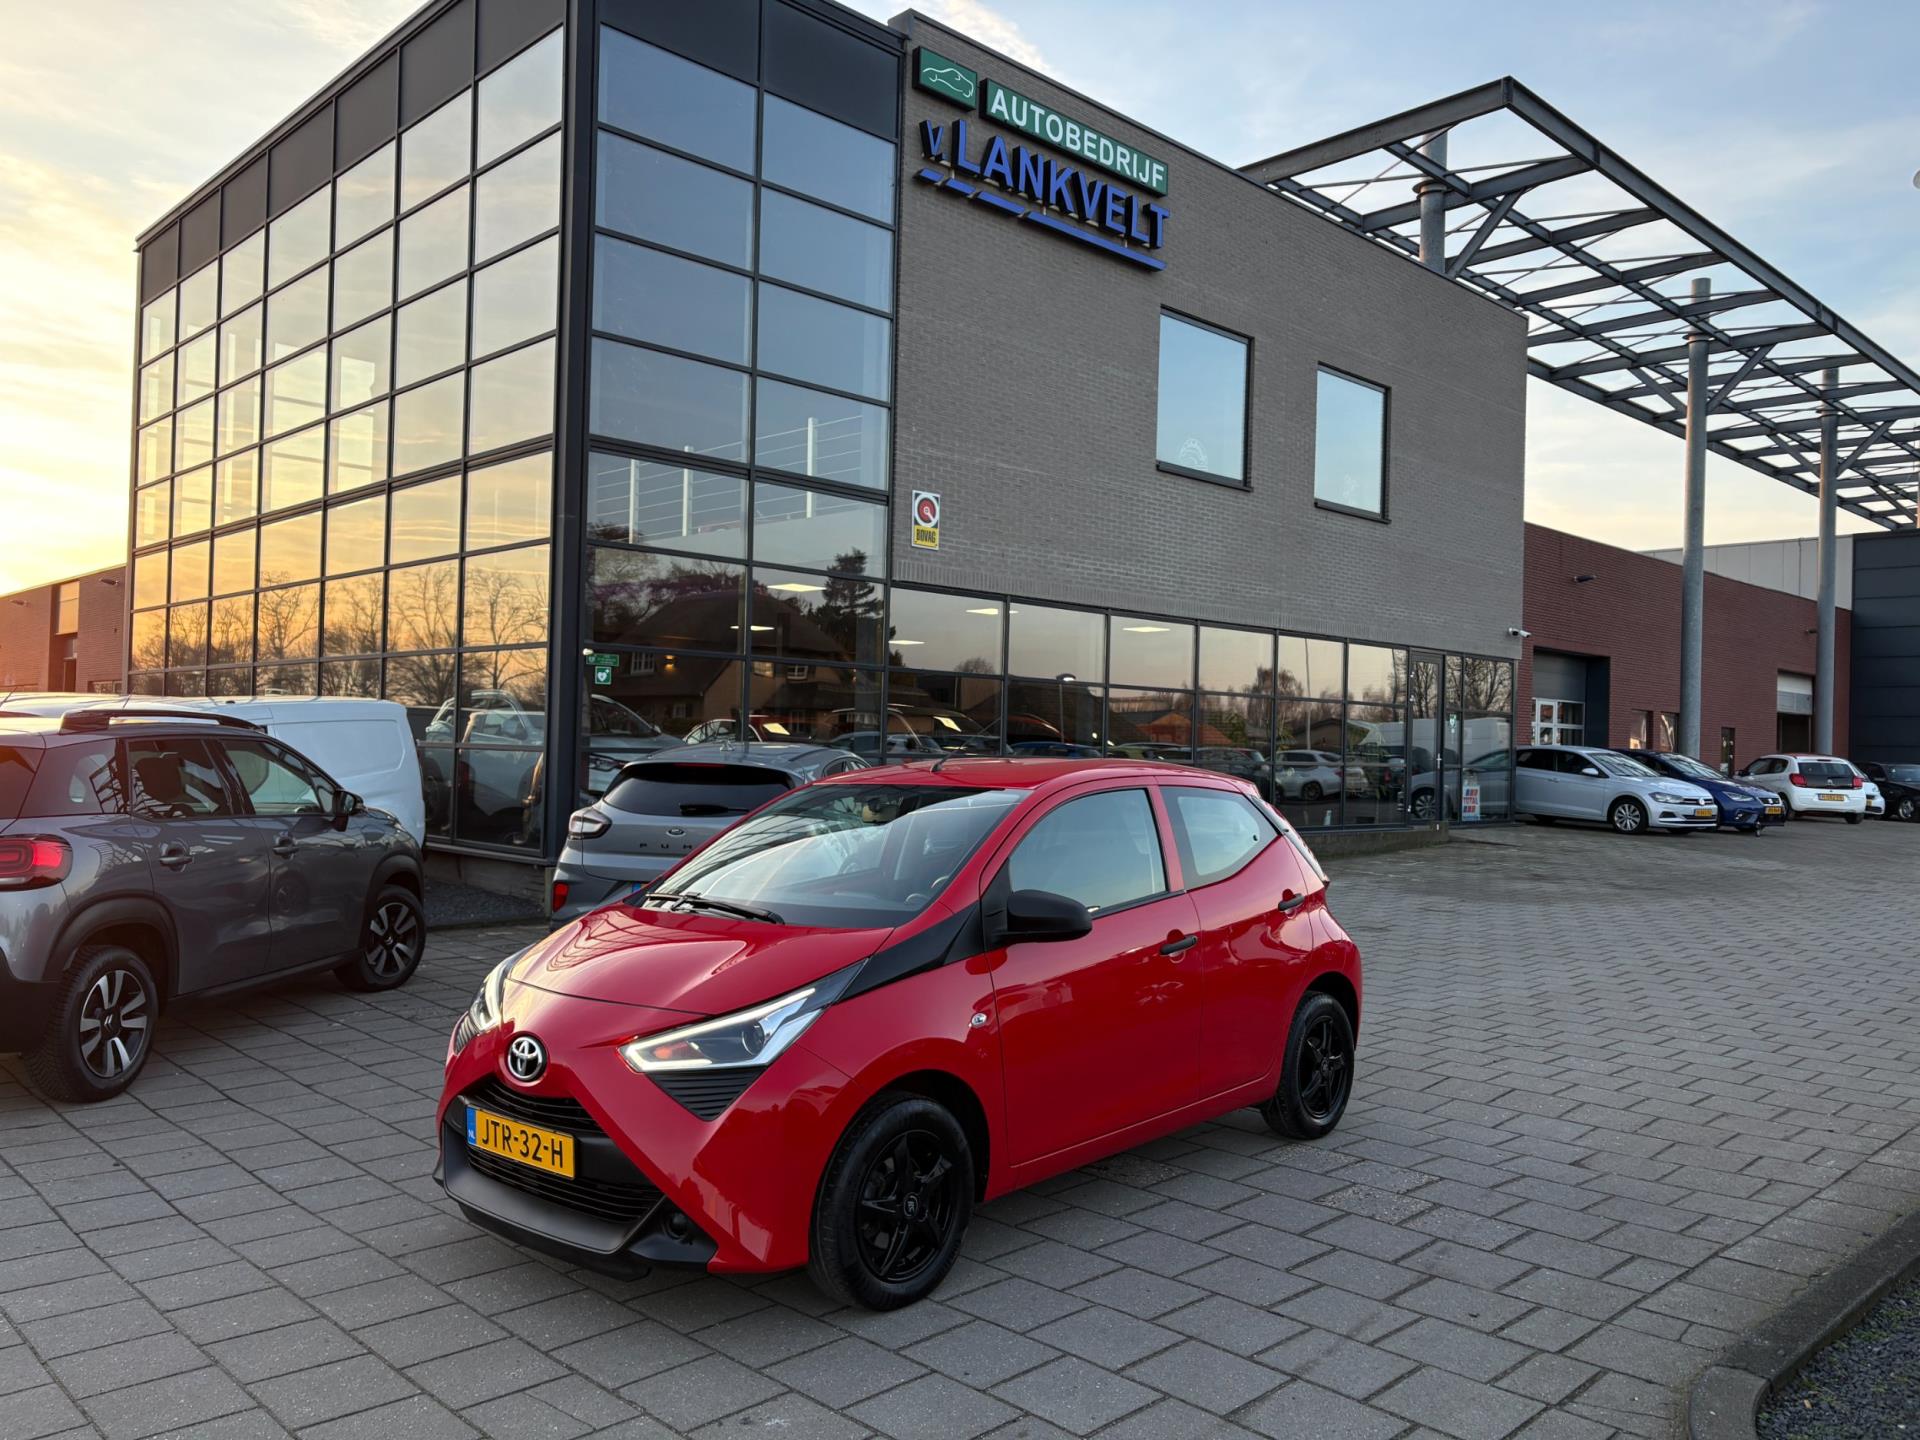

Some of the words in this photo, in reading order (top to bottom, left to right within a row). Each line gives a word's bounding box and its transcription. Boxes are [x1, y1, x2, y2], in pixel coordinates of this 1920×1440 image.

[990, 88, 1165, 189] AUTOBEDRIJF
[952, 118, 1170, 249] LANKVELT
[916, 528, 936, 543] BOVAG
[482, 1118, 564, 1169] JTR-32-H
